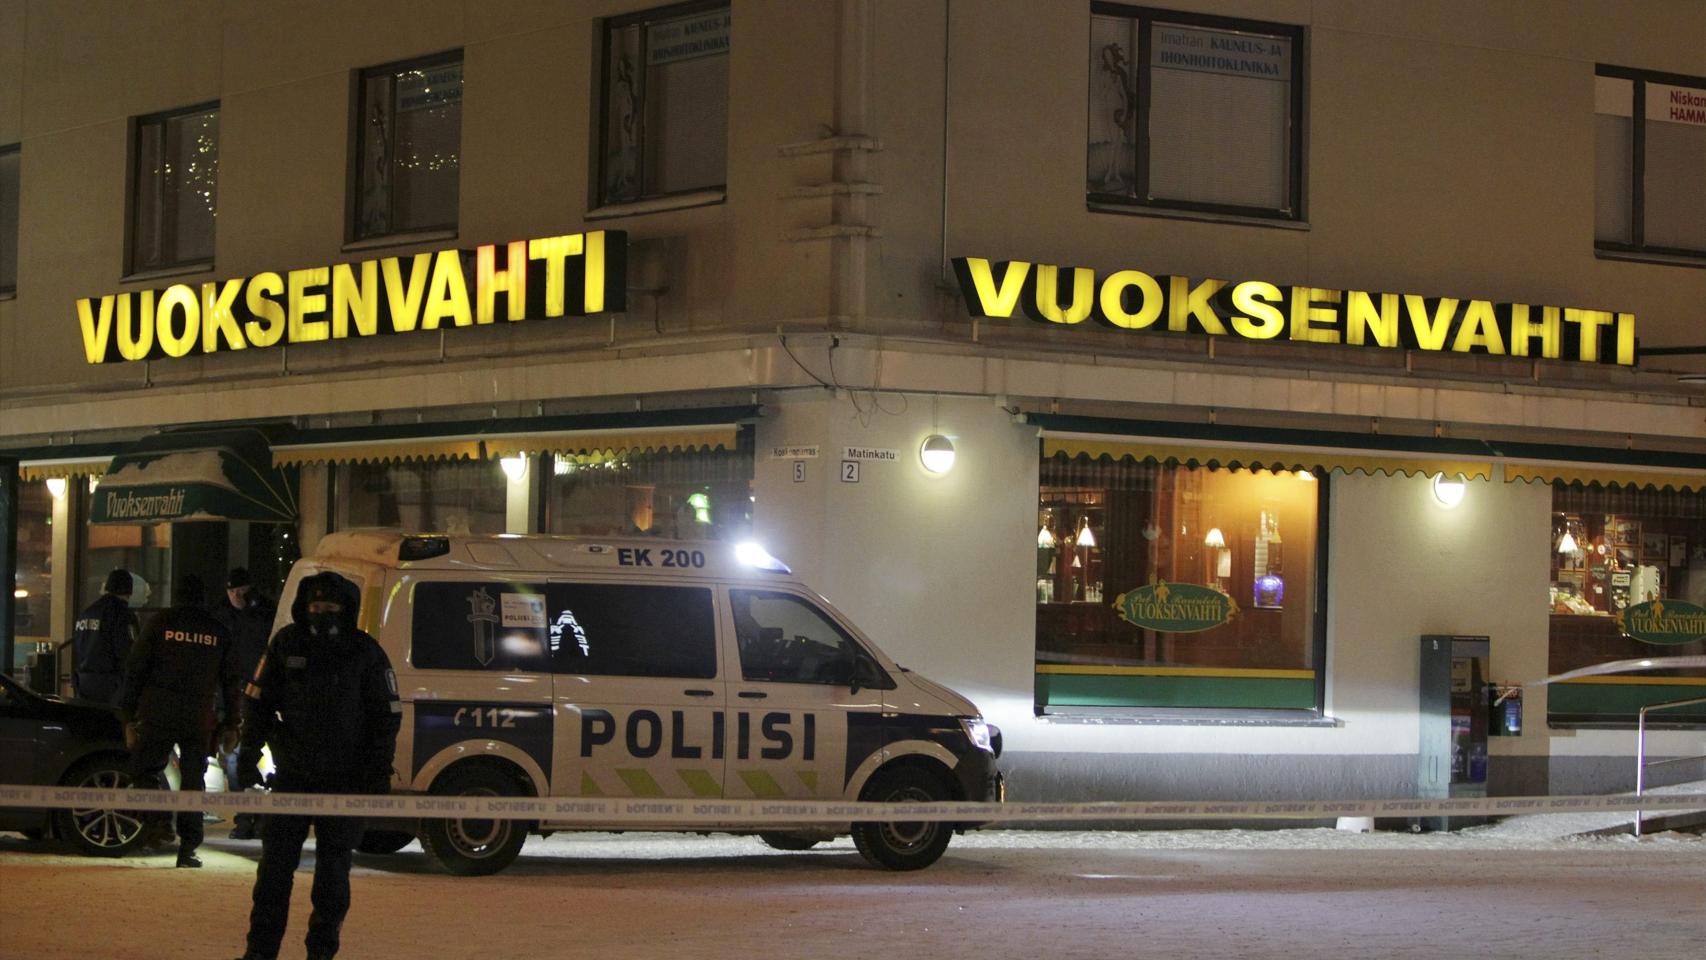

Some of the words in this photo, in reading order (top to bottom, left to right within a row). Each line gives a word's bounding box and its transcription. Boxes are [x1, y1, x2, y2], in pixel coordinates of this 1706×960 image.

[1161, 31, 1203, 48] Imatran
[1271, 44, 1282, 57] JA
[77, 230, 606, 364] VUOKSENVAHTI
[966, 257, 1636, 365] VUOKSENVAHTI
[848, 448, 895, 460] Matinkatu
[796, 464, 802, 480] 5
[846, 464, 854, 479] 2
[106, 487, 185, 518] Vuoksenvahti
[617, 547, 653, 566] EK
[661, 549, 705, 568] 200
[1131, 602, 1221, 621] VUOKSENVAHTI
[165, 630, 217, 647] POLIISI
[471, 707, 515, 728] 112
[580, 709, 816, 761] POLIISI
